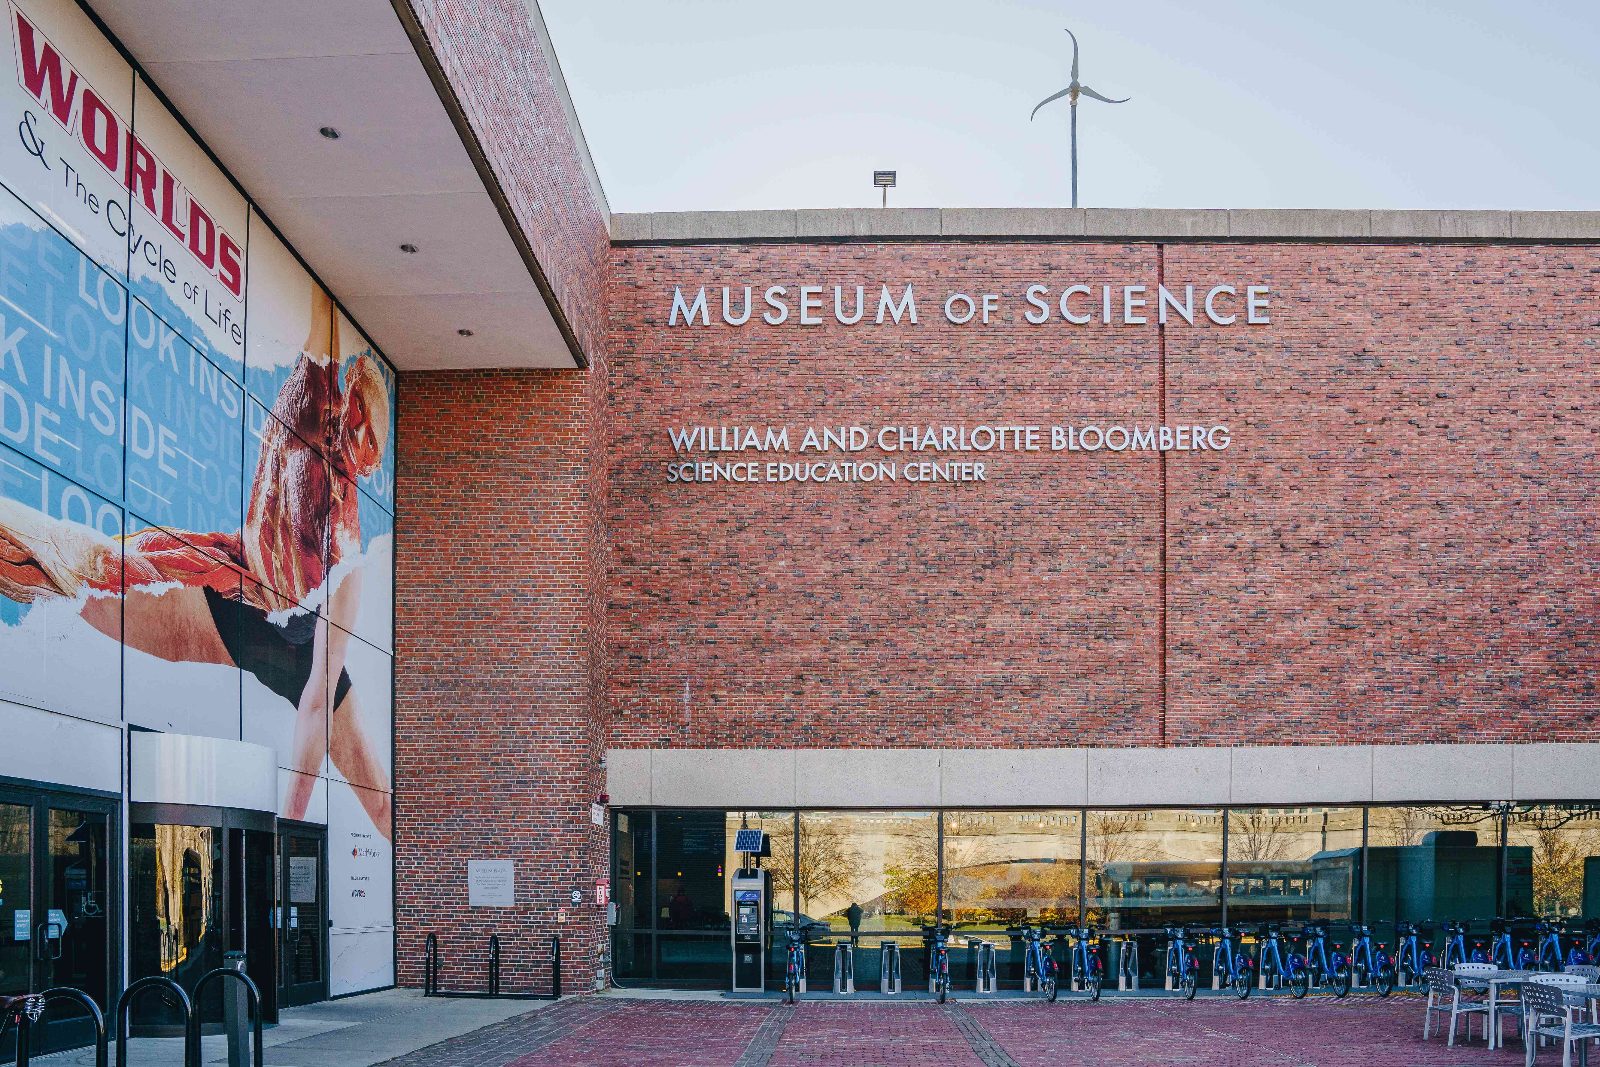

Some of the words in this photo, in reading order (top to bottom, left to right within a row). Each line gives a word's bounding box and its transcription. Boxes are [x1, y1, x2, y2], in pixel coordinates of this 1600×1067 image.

[16, 11, 244, 299] WORLDS
[18, 110, 51, 171] &
[59, 157, 100, 216] The
[106, 199, 177, 284] Cycle
[183, 281, 199, 304] of
[204, 288, 242, 346] Life
[78, 252, 182, 375] LOOK
[189, 343, 267, 439] INSID
[668, 283, 918, 327] MUSEUM
[944, 293, 999, 324] OF
[1024, 282, 1271, 326] SCIENCE
[43, 344, 178, 479] INSIDE
[667, 462, 759, 482] SCIENCE
[766, 462, 896, 482] EDUCATION
[903, 461, 987, 482] CENTER
[668, 426, 789, 452] WILLIAM
[800, 426, 869, 452] AND
[877, 425, 1040, 451] CHARLOTTE
[1051, 425, 1232, 451] BLOOMBERG
